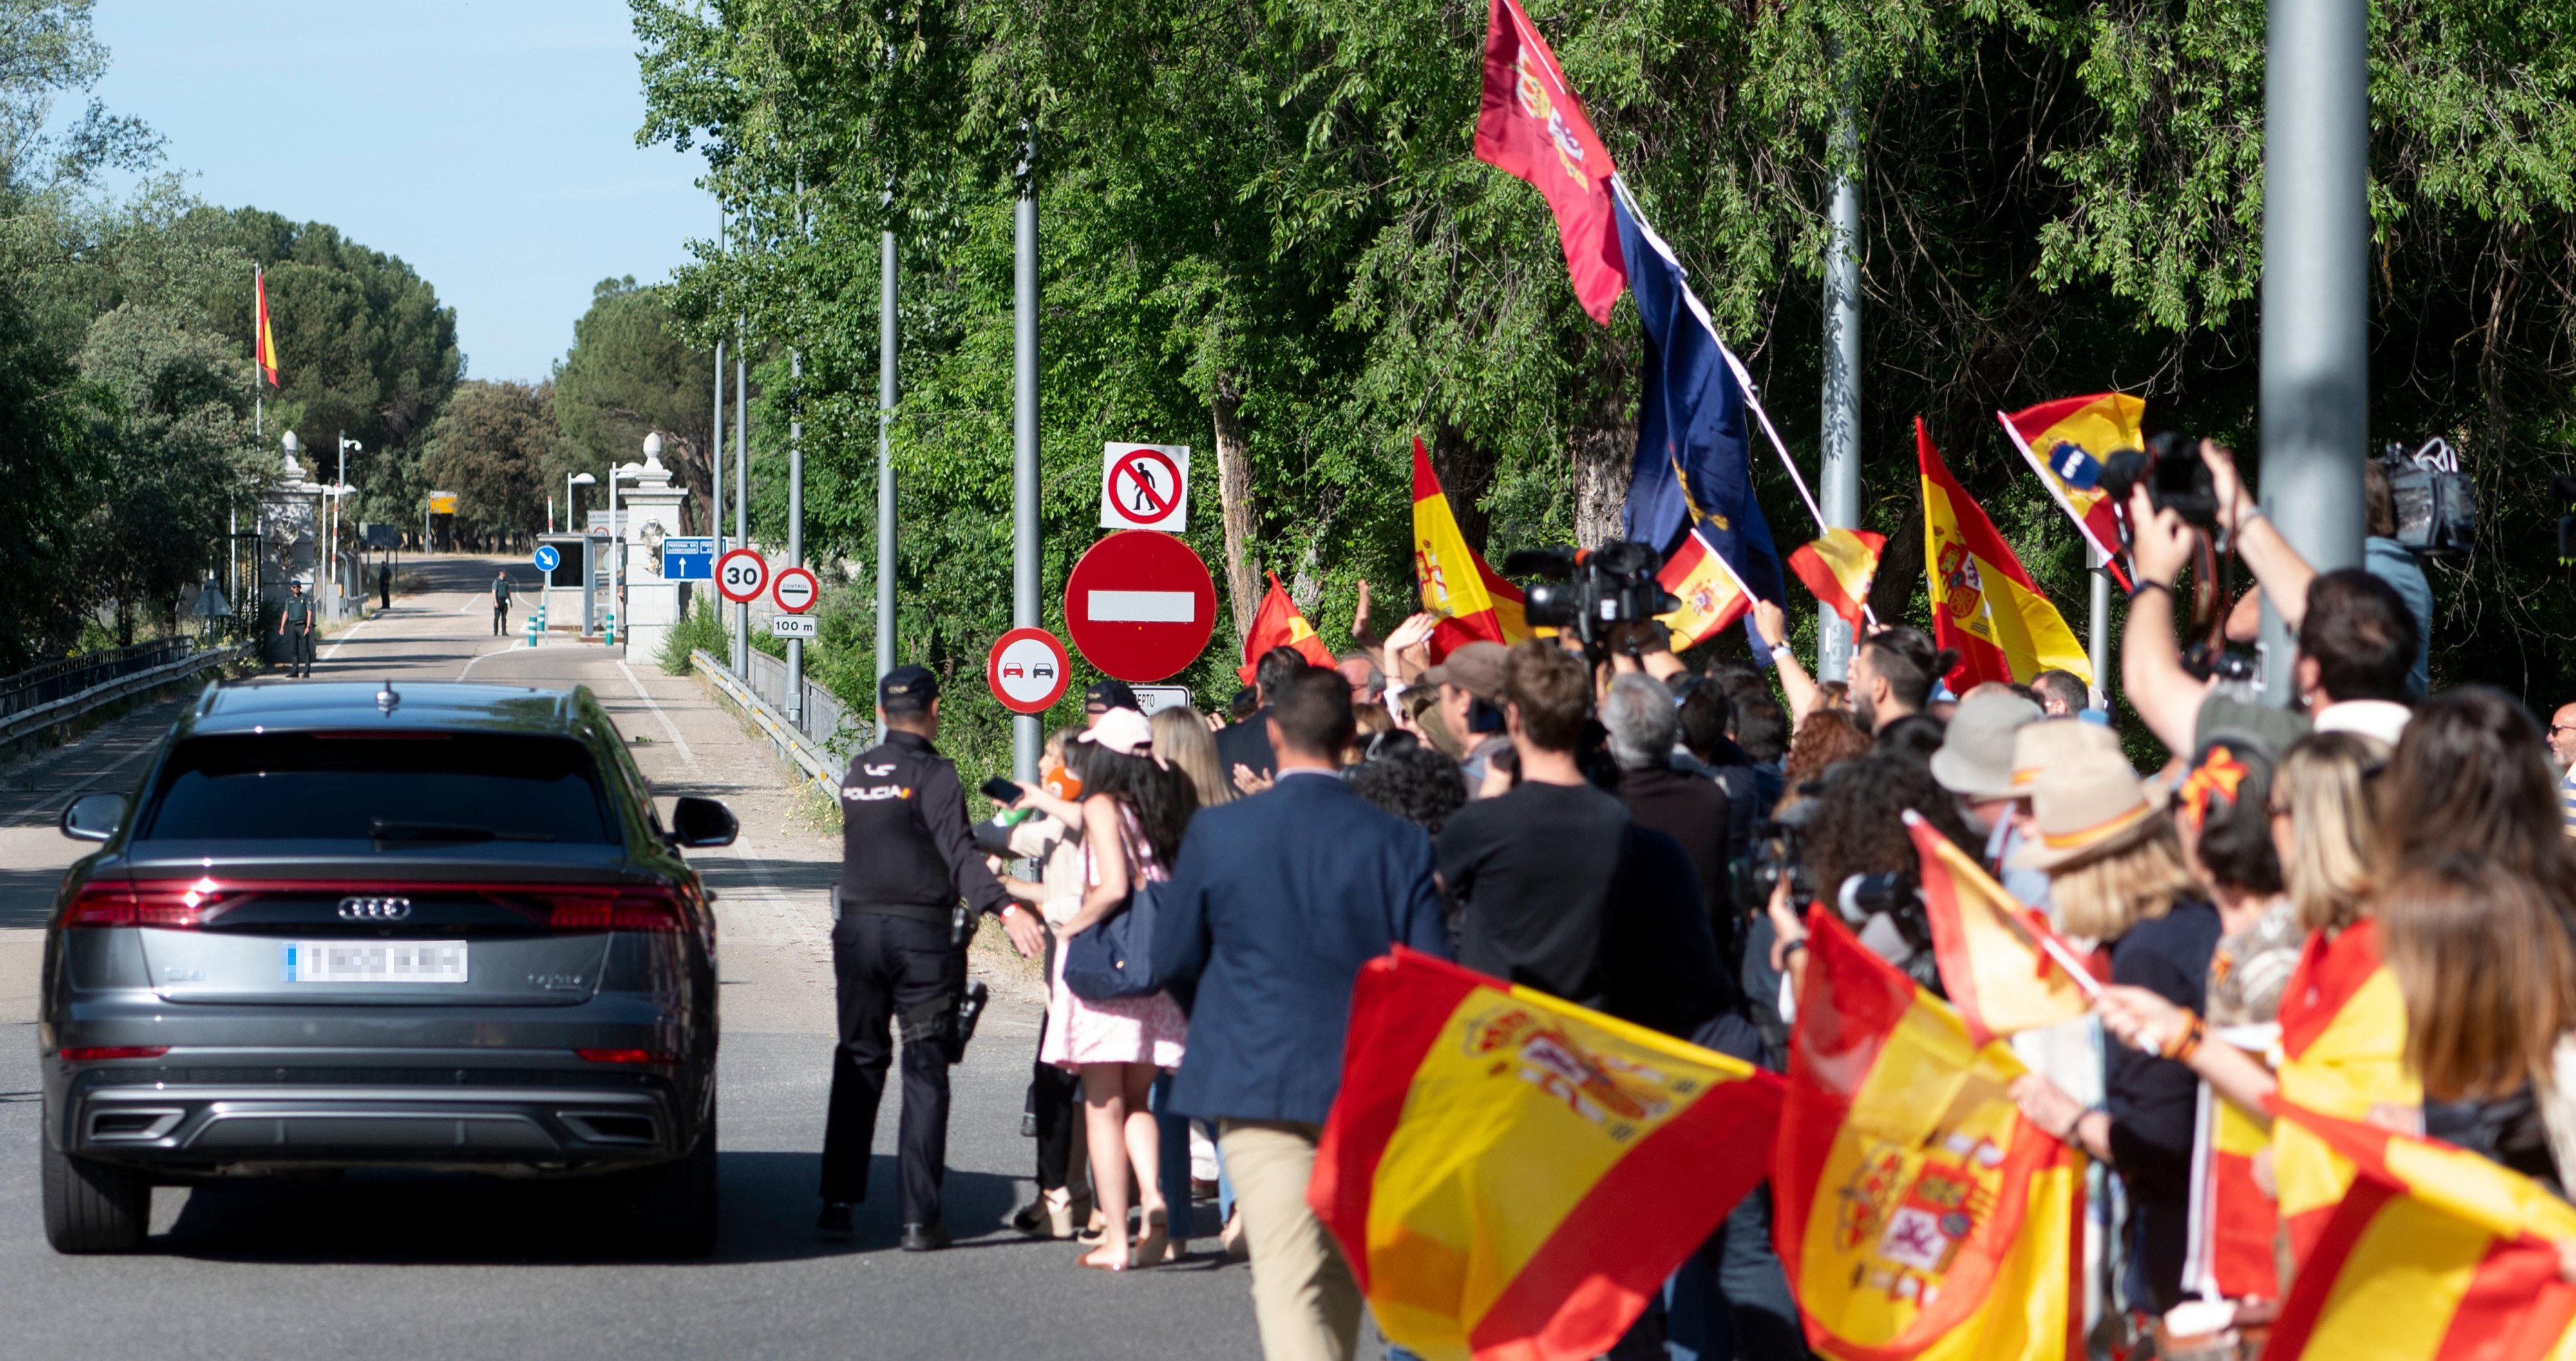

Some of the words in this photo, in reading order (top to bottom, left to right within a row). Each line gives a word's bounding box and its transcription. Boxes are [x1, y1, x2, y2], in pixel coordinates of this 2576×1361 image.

[727, 567, 757, 585] 30
[776, 622, 799, 631] 100
[1137, 694, 1155, 707] EPTO
[842, 785, 902, 801] POLICIA
